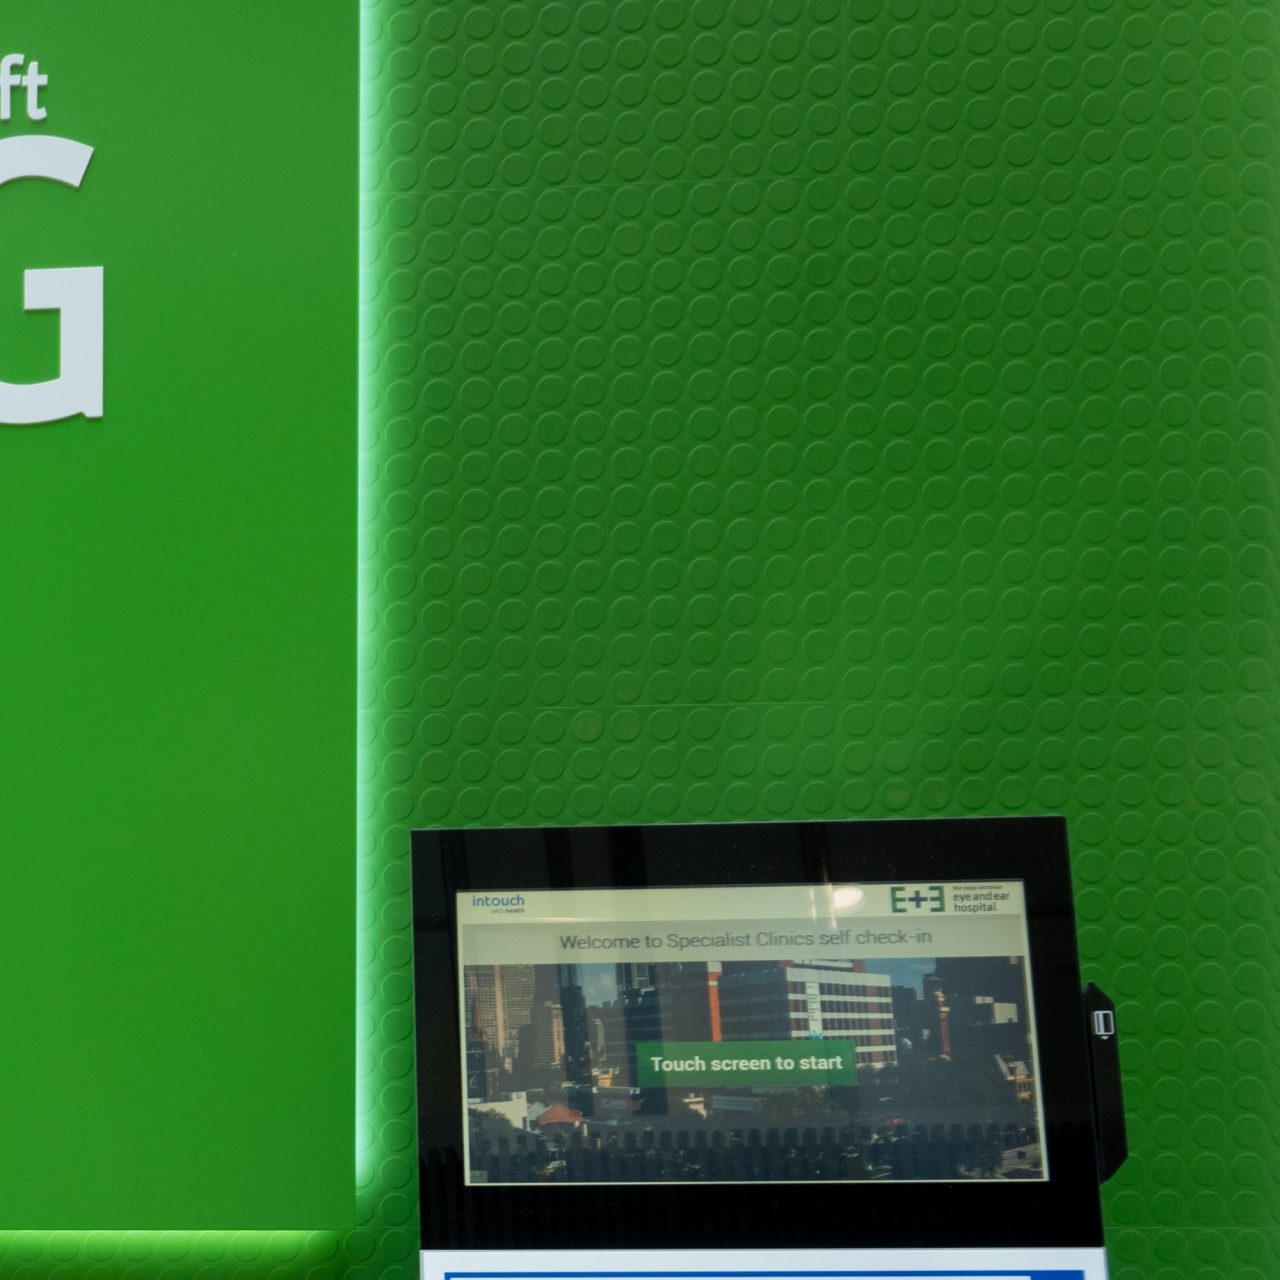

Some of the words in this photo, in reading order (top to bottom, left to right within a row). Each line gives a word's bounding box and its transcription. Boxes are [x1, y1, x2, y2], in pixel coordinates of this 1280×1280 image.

[472, 893, 525, 906] intouch
[954, 902, 998, 914] hospital
[560, 934, 640, 950] Welcome
[645, 935, 662, 949] to
[666, 932, 751, 951] Specialist
[756, 931, 814, 946] Clinics
[819, 930, 850, 946] self
[856, 928, 933, 944] check-in
[650, 1055, 706, 1072] Touch
[711, 1058, 771, 1071] screen
[775, 1056, 795, 1070] to
[799, 1055, 843, 1070] start
